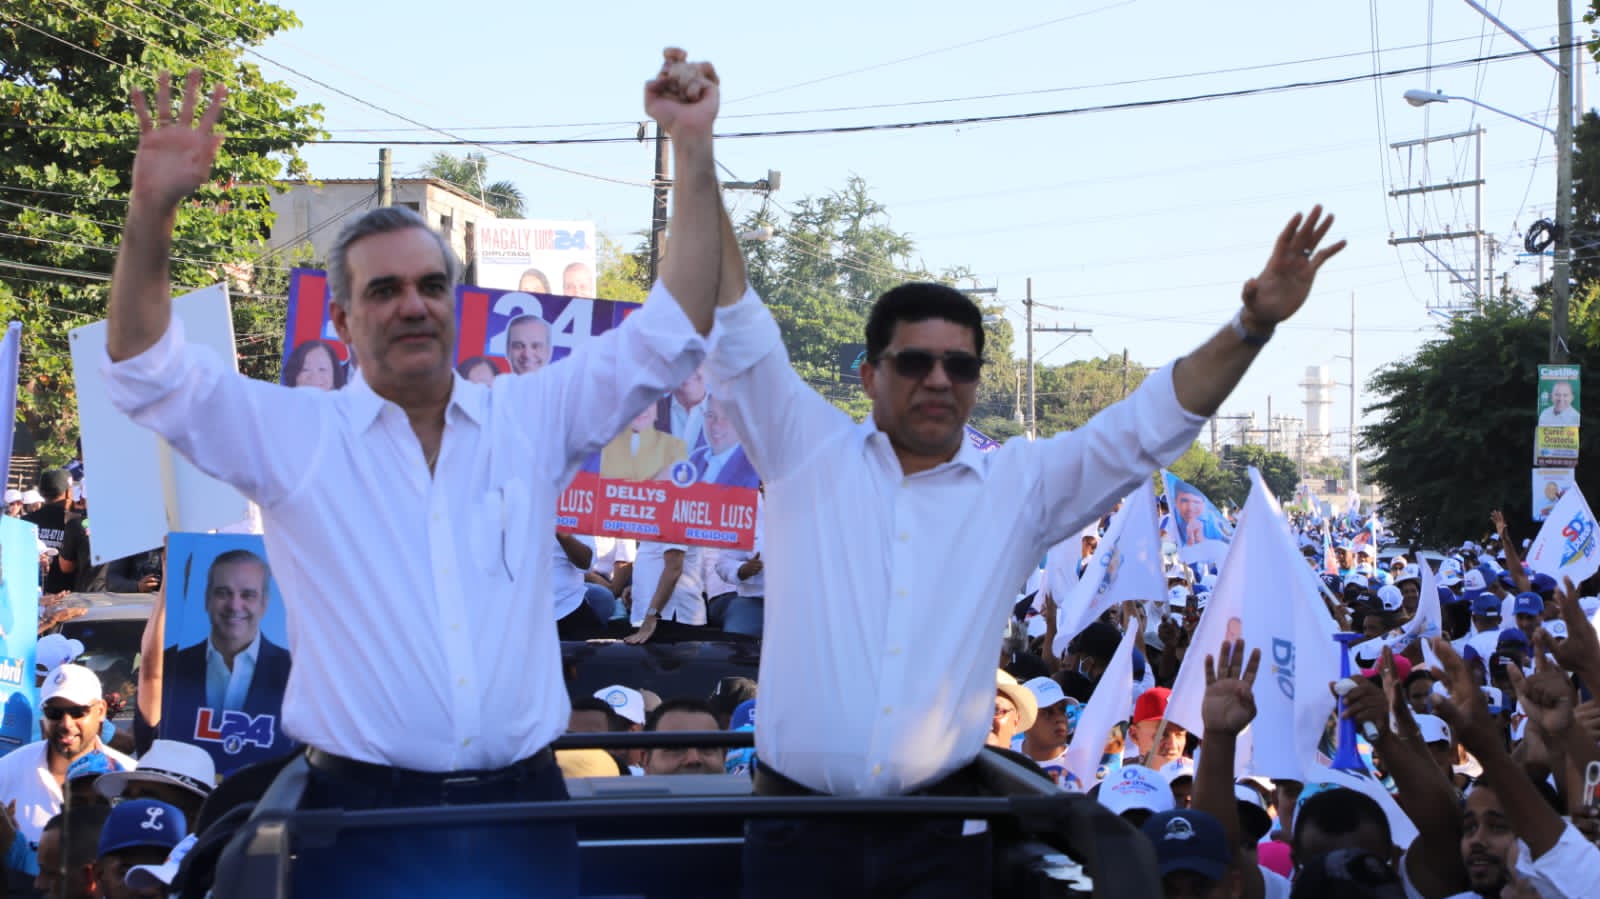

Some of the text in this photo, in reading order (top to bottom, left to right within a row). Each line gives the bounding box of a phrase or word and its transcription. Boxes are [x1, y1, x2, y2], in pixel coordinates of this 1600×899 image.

[481, 227, 531, 250] MAGALY
[1540, 367, 1579, 377] Castillo
[559, 489, 594, 514] LUIS
[606, 484, 667, 503] DELLYS
[609, 503, 657, 520] FELIZ
[672, 499, 754, 529] ANGEL LUIS
[603, 519, 660, 535] DIPUTADA
[685, 527, 738, 542] REGIDOR
[194, 707, 275, 750] L24
[140, 806, 165, 832] L
